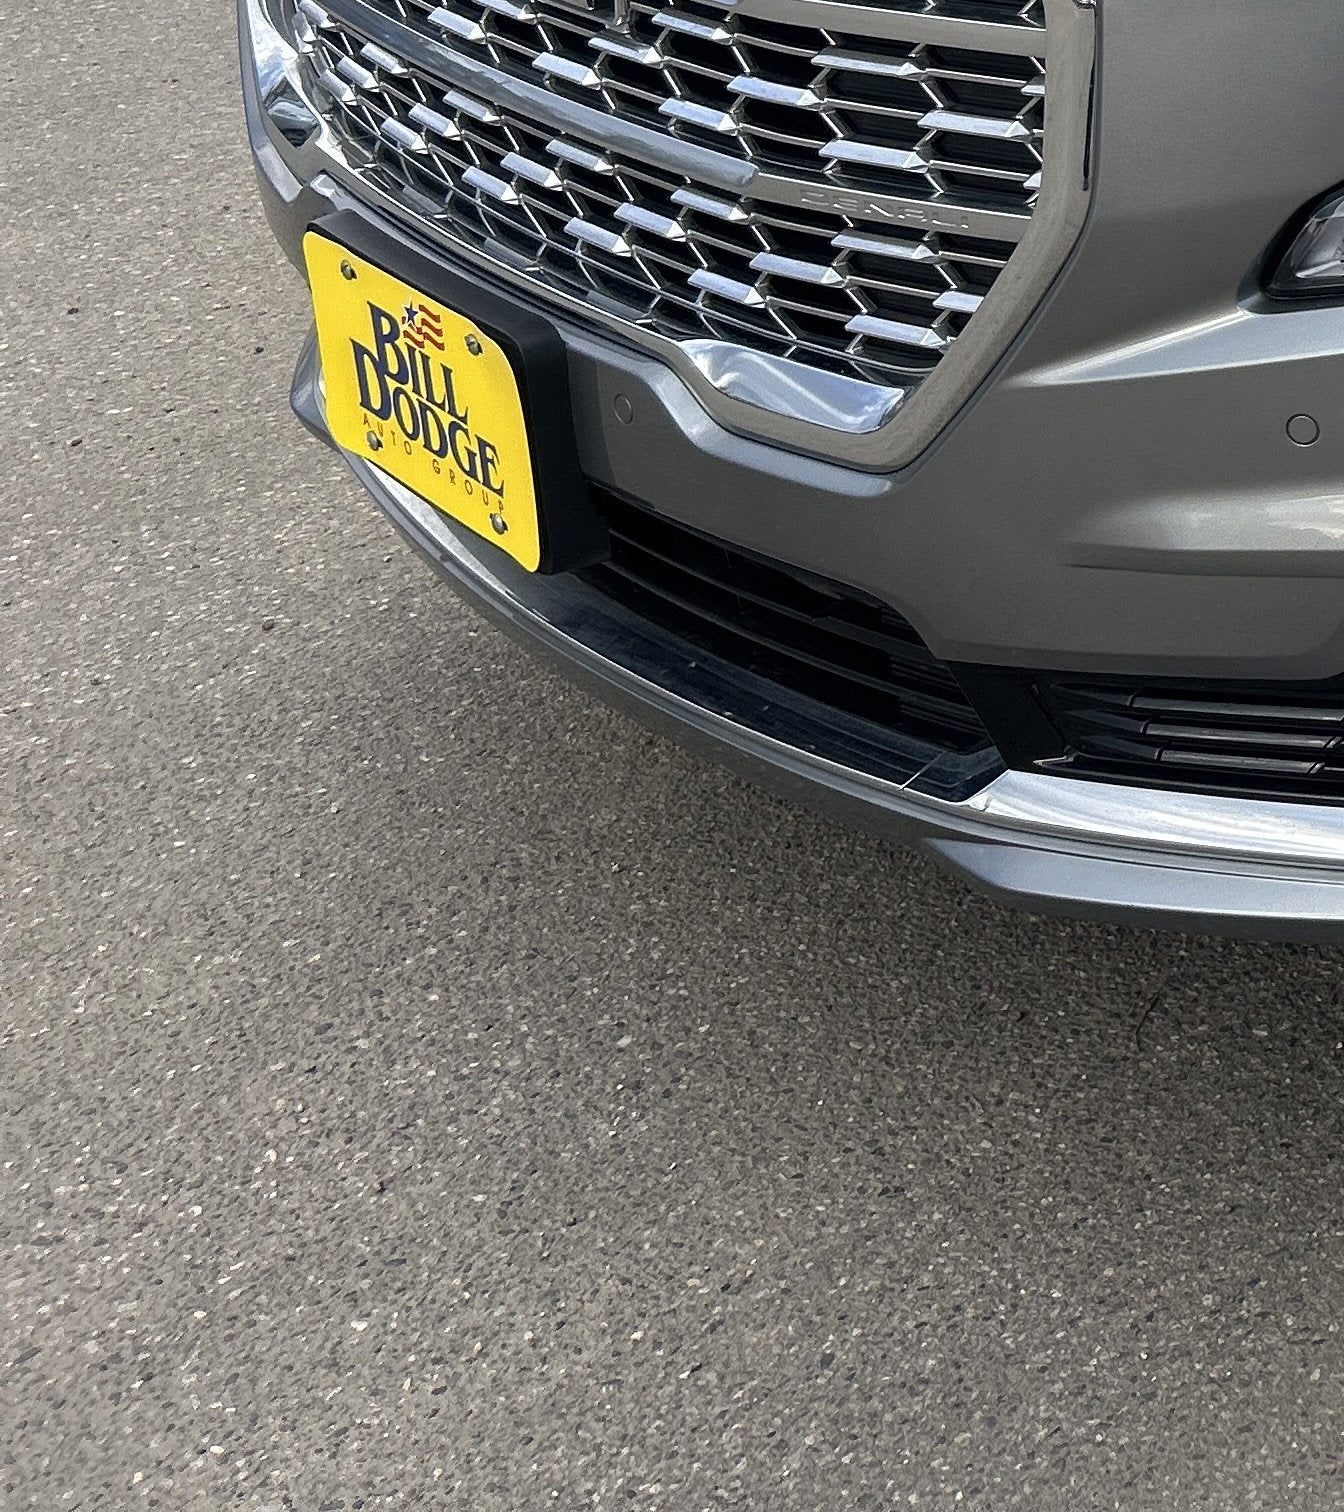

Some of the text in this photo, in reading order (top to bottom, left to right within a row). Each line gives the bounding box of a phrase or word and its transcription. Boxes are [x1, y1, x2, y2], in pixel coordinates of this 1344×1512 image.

[800, 190, 970, 229] DENALI
[349, 337, 505, 499] DODGE
[367, 300, 470, 427] BILL
[362, 412, 505, 516] AUTO GROUP
